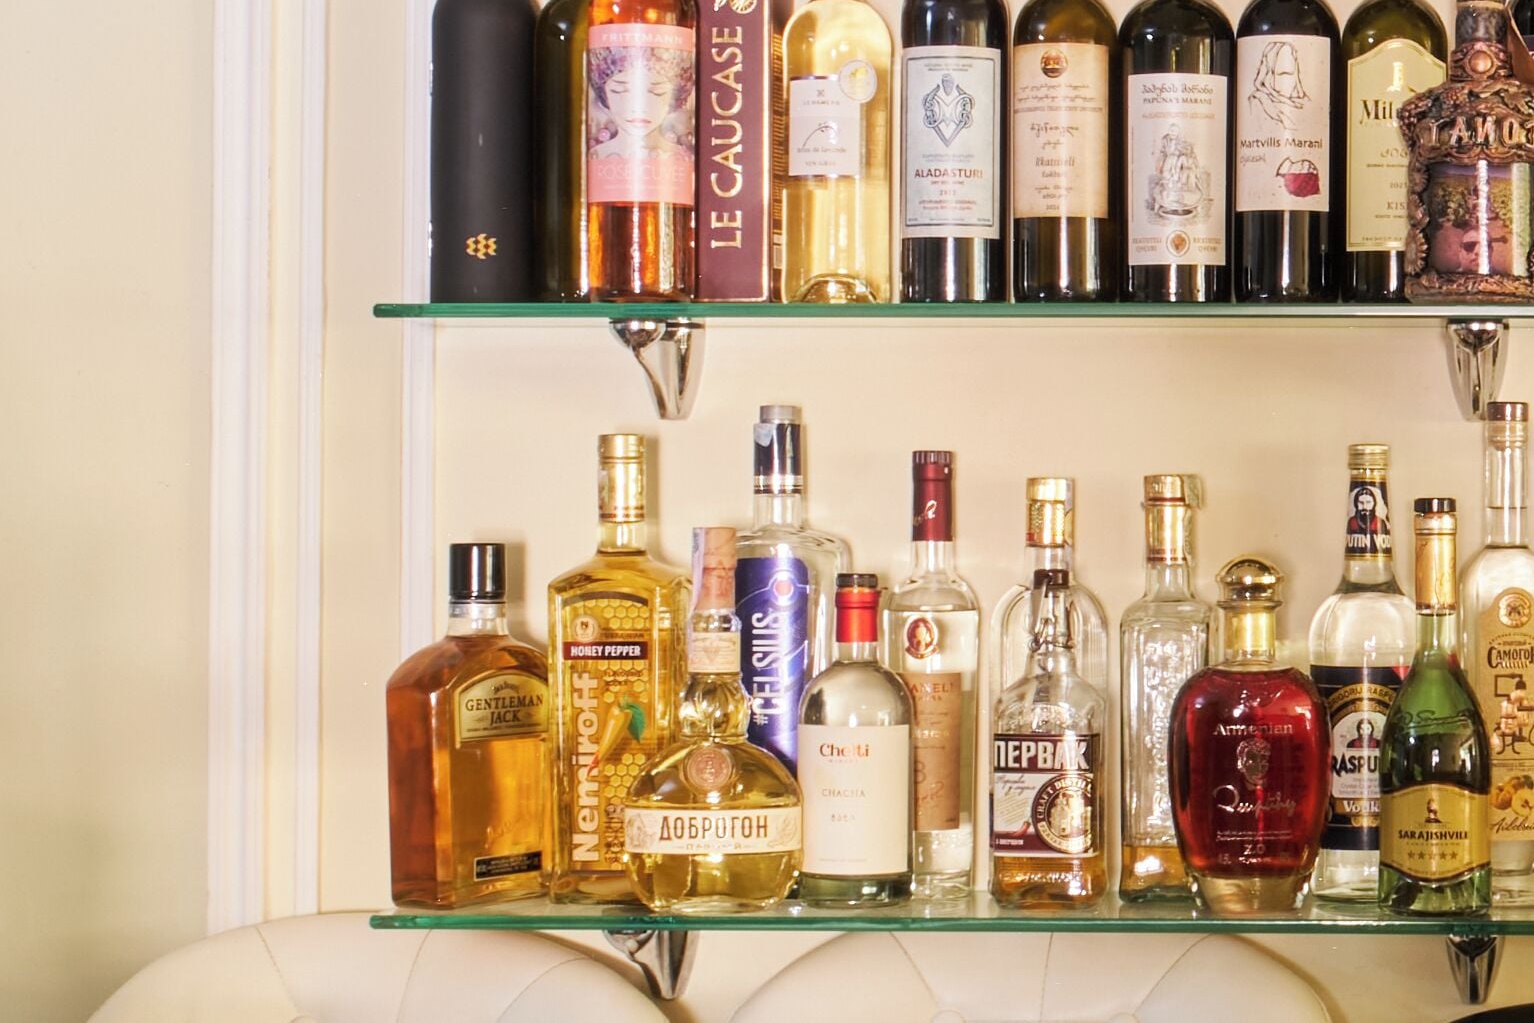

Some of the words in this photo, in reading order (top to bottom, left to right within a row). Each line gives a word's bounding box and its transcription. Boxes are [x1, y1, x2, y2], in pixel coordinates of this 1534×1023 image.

[602, 33, 683, 45] FRITTMANN
[710, 25, 743, 198] CAUCASE
[1240, 137, 1281, 149] Martvilis
[1285, 138, 1323, 150] Marani
[914, 167, 984, 179] ALADASTURI
[711, 209, 743, 249] LE
[570, 645, 603, 657] HONEY
[604, 645, 642, 657] PEPPER
[465, 693, 544, 712] GENTLEMAN
[490, 709, 521, 727] JACK
[1213, 722, 1294, 736] Armenian
[819, 743, 870, 757] Cheti
[994, 740, 1090, 770] ПЕРВАК
[572, 671, 599, 863] Nemiroff
[821, 788, 867, 798] CHACHA
[659, 815, 769, 842] ДОБРОГОН
[1397, 830, 1468, 842] SARAJISHVILI
